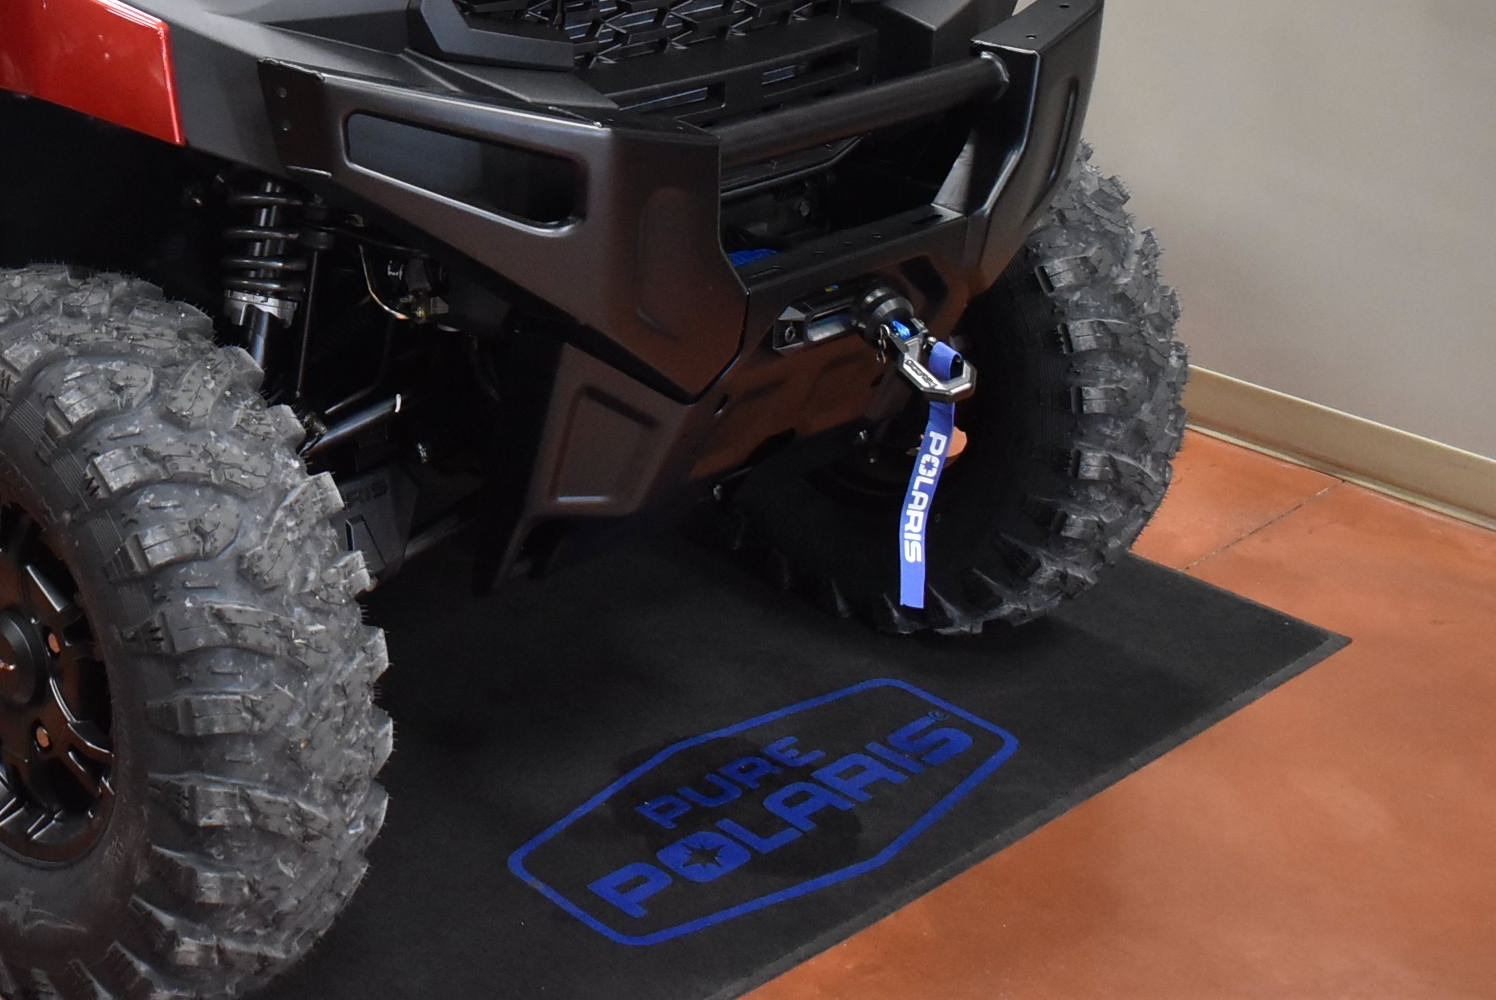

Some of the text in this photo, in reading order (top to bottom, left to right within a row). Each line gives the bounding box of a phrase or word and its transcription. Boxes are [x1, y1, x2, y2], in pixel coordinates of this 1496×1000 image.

[904, 431, 947, 563] POLARIS
[587, 713, 974, 918] POLARIS
[635, 735, 826, 829] PURE
